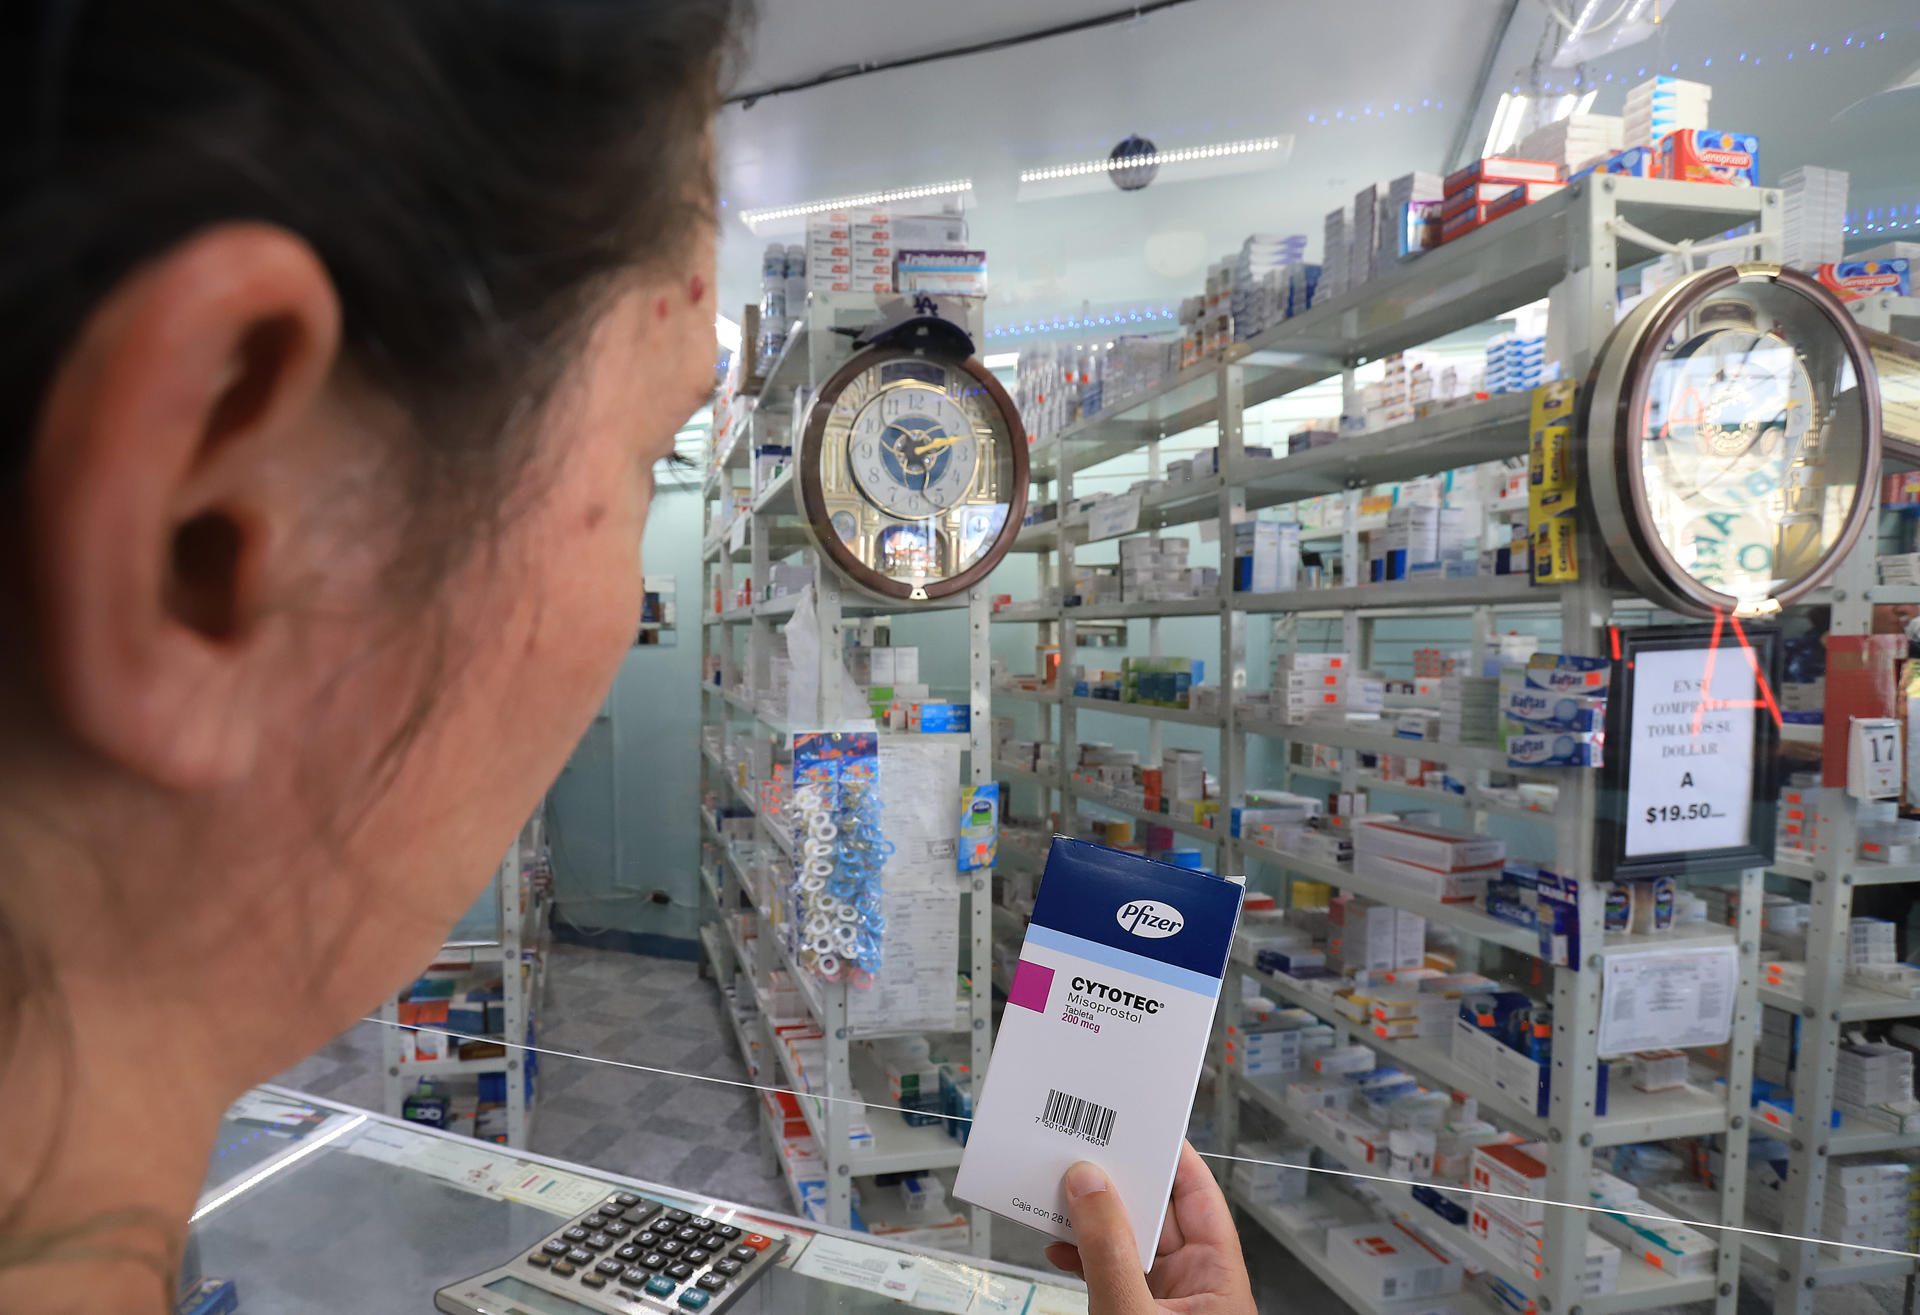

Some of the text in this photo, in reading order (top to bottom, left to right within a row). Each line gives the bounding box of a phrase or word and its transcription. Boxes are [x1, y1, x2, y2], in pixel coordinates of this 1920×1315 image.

[887, 399, 899, 415] 11
[909, 394, 924, 409] 12
[1673, 680, 1690, 693] EN
[1662, 743, 1719, 758] DOLLAR
[1871, 735, 1896, 763] 17
[1680, 771, 1694, 788] A
[1646, 803, 1711, 824] $19.50
[1120, 903, 1181, 935] Pfizer
[1064, 1004, 1094, 1021] Tableta
[1067, 992, 1143, 1024] Misoprostol
[1061, 1012, 1101, 1034] 200 mcg
[1011, 1196, 1032, 1212] Caja
[1033, 1205, 1050, 1219] con
[1051, 1212, 1064, 1224] 28
[751, 1235, 763, 1243] C
